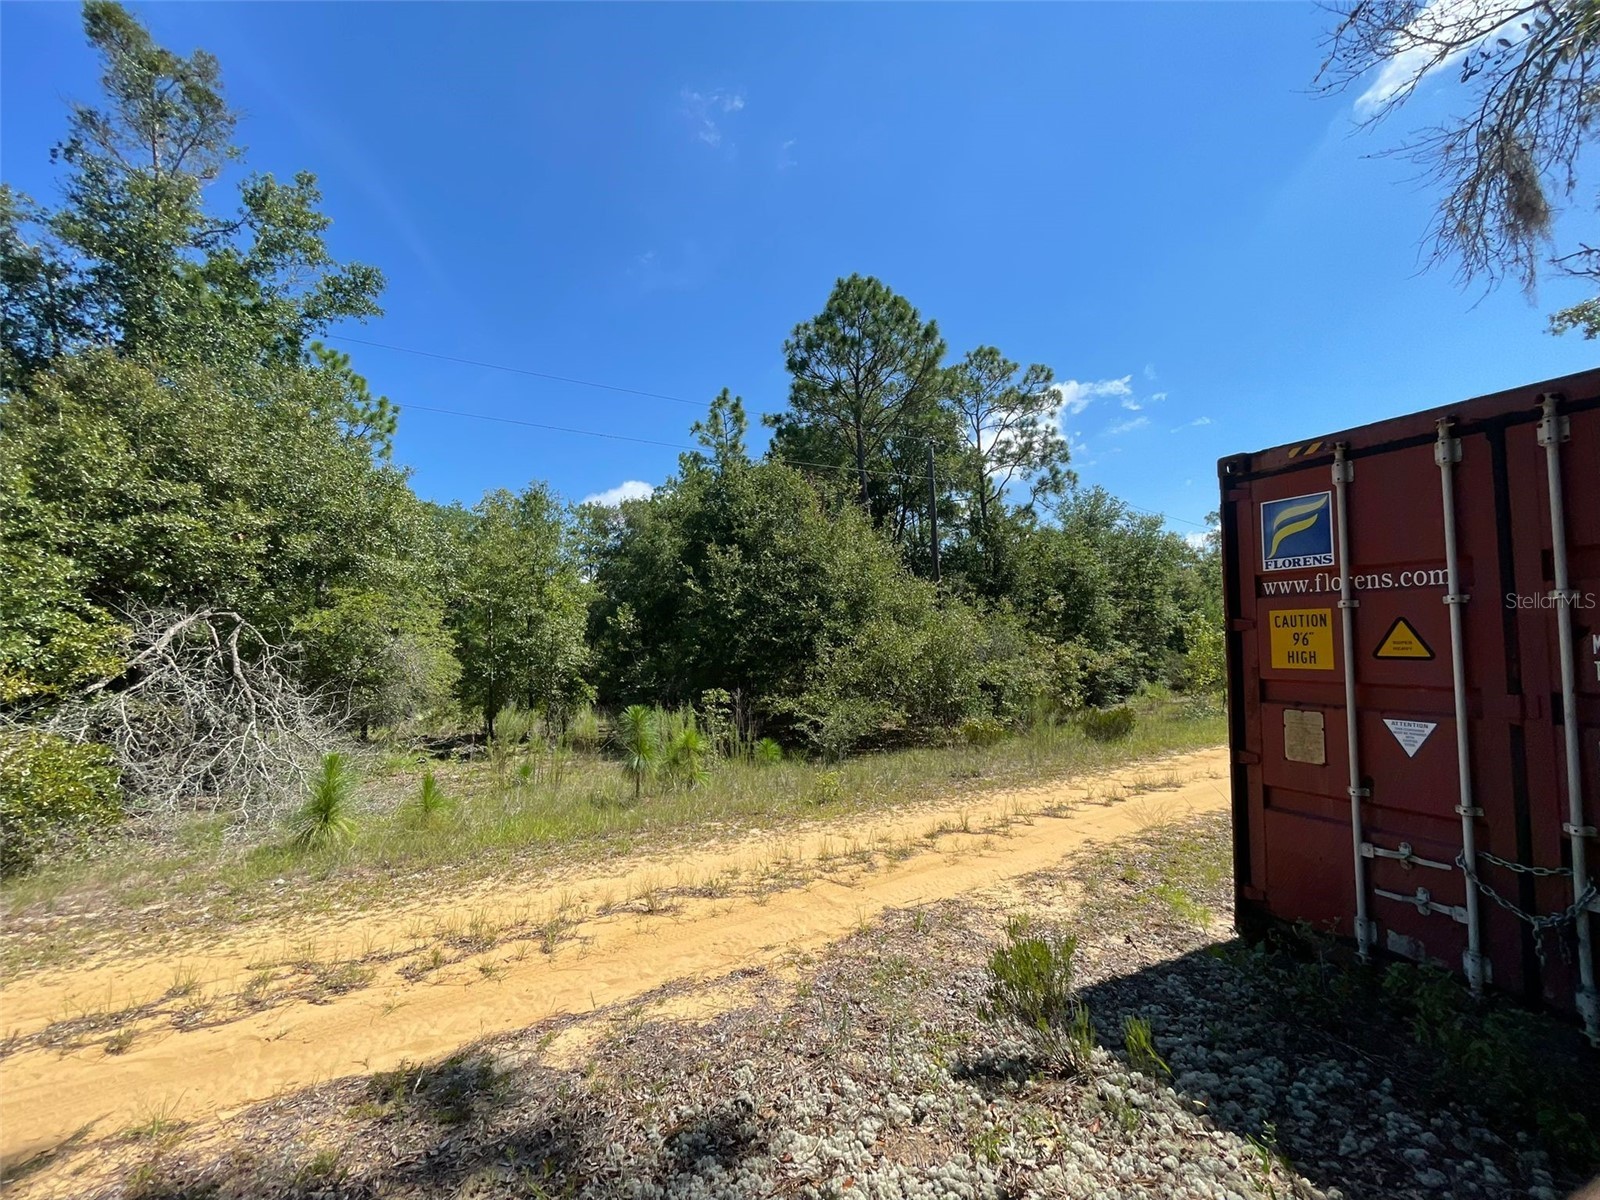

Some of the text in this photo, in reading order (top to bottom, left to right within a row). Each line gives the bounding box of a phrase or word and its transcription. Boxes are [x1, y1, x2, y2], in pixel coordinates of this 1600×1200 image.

[1264, 554, 1334, 570] FLORENS
[1262, 567, 1449, 595] www.floens.com
[1274, 613, 1327, 628] CAUTION
[1287, 651, 1317, 665] HIGH
[1391, 720, 1429, 729] ATTENTION
